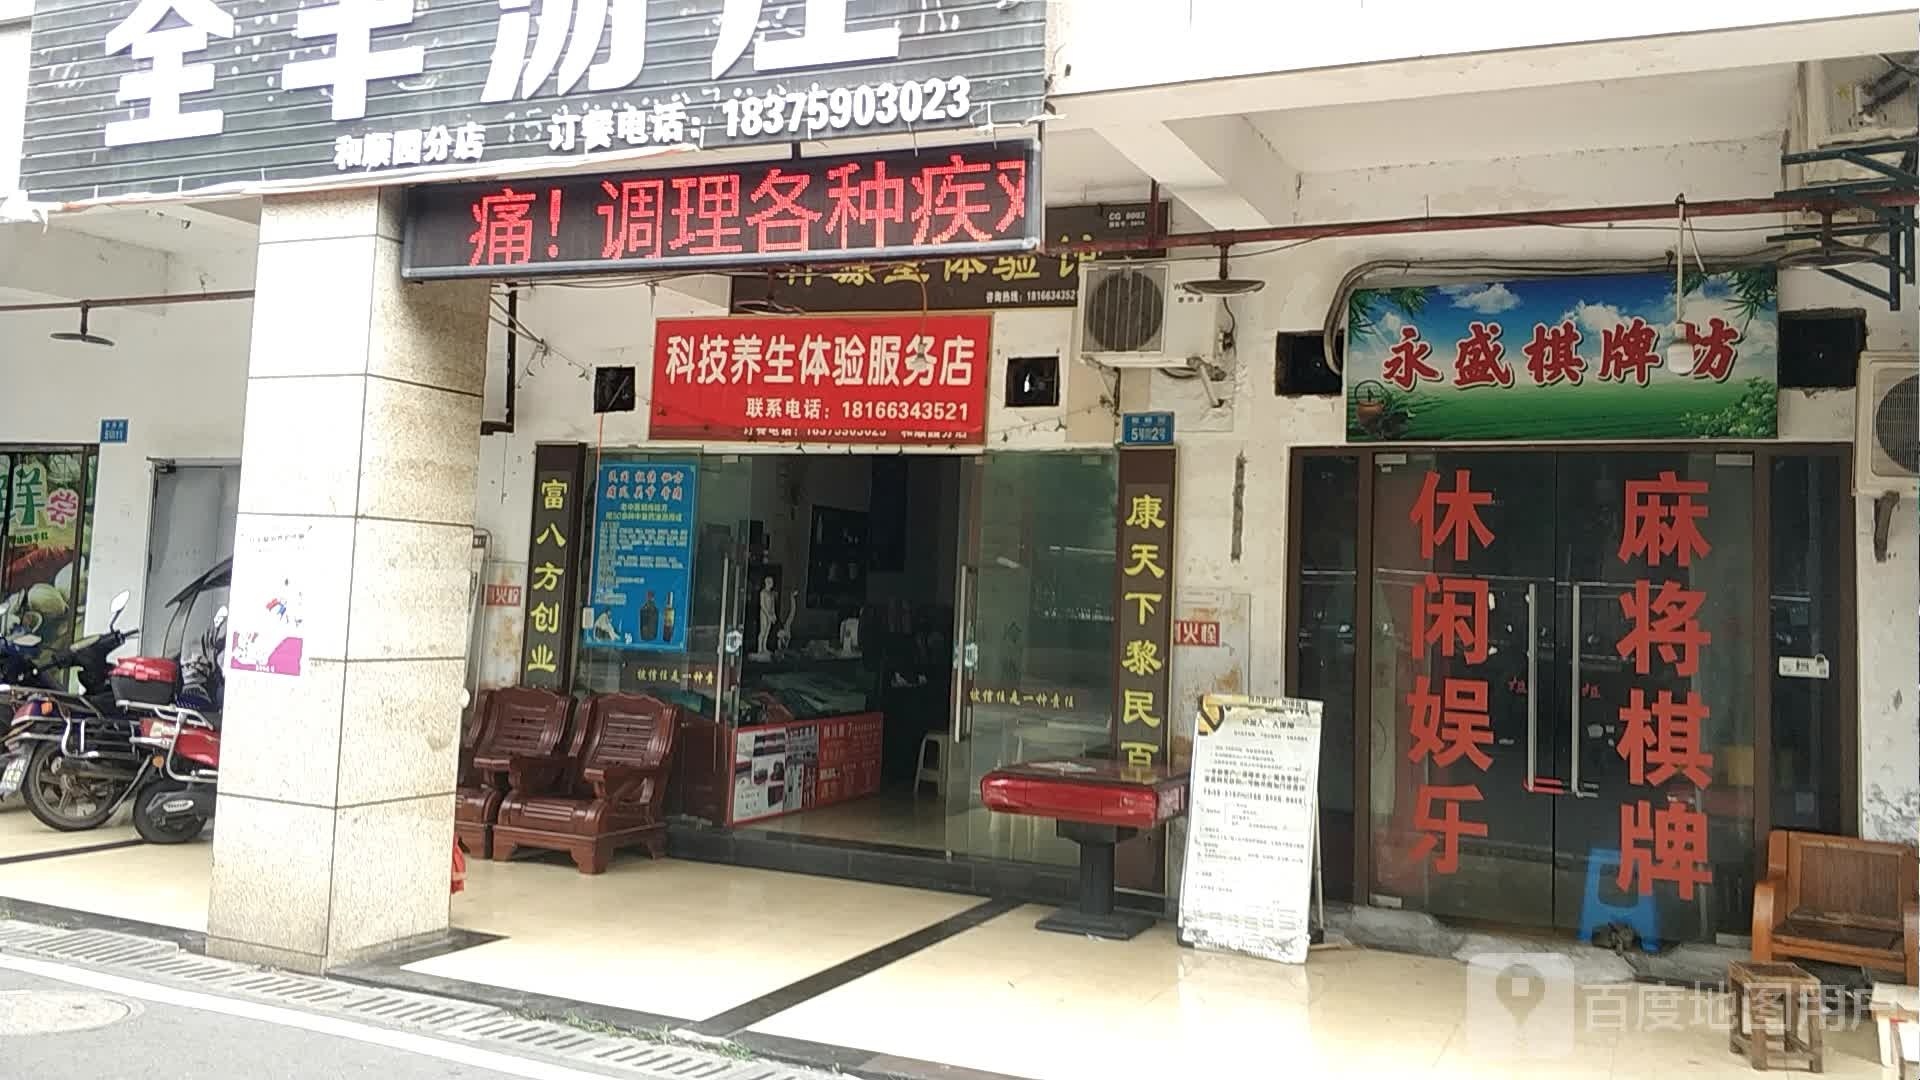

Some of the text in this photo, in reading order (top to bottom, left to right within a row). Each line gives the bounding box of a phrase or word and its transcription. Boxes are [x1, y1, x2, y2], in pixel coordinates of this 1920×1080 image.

[665, 333, 976, 387] 科技养生体验服务店
[1406, 469, 1496, 875] 休闲娱乐
[1615, 470, 1714, 901] 麻将棋牌
